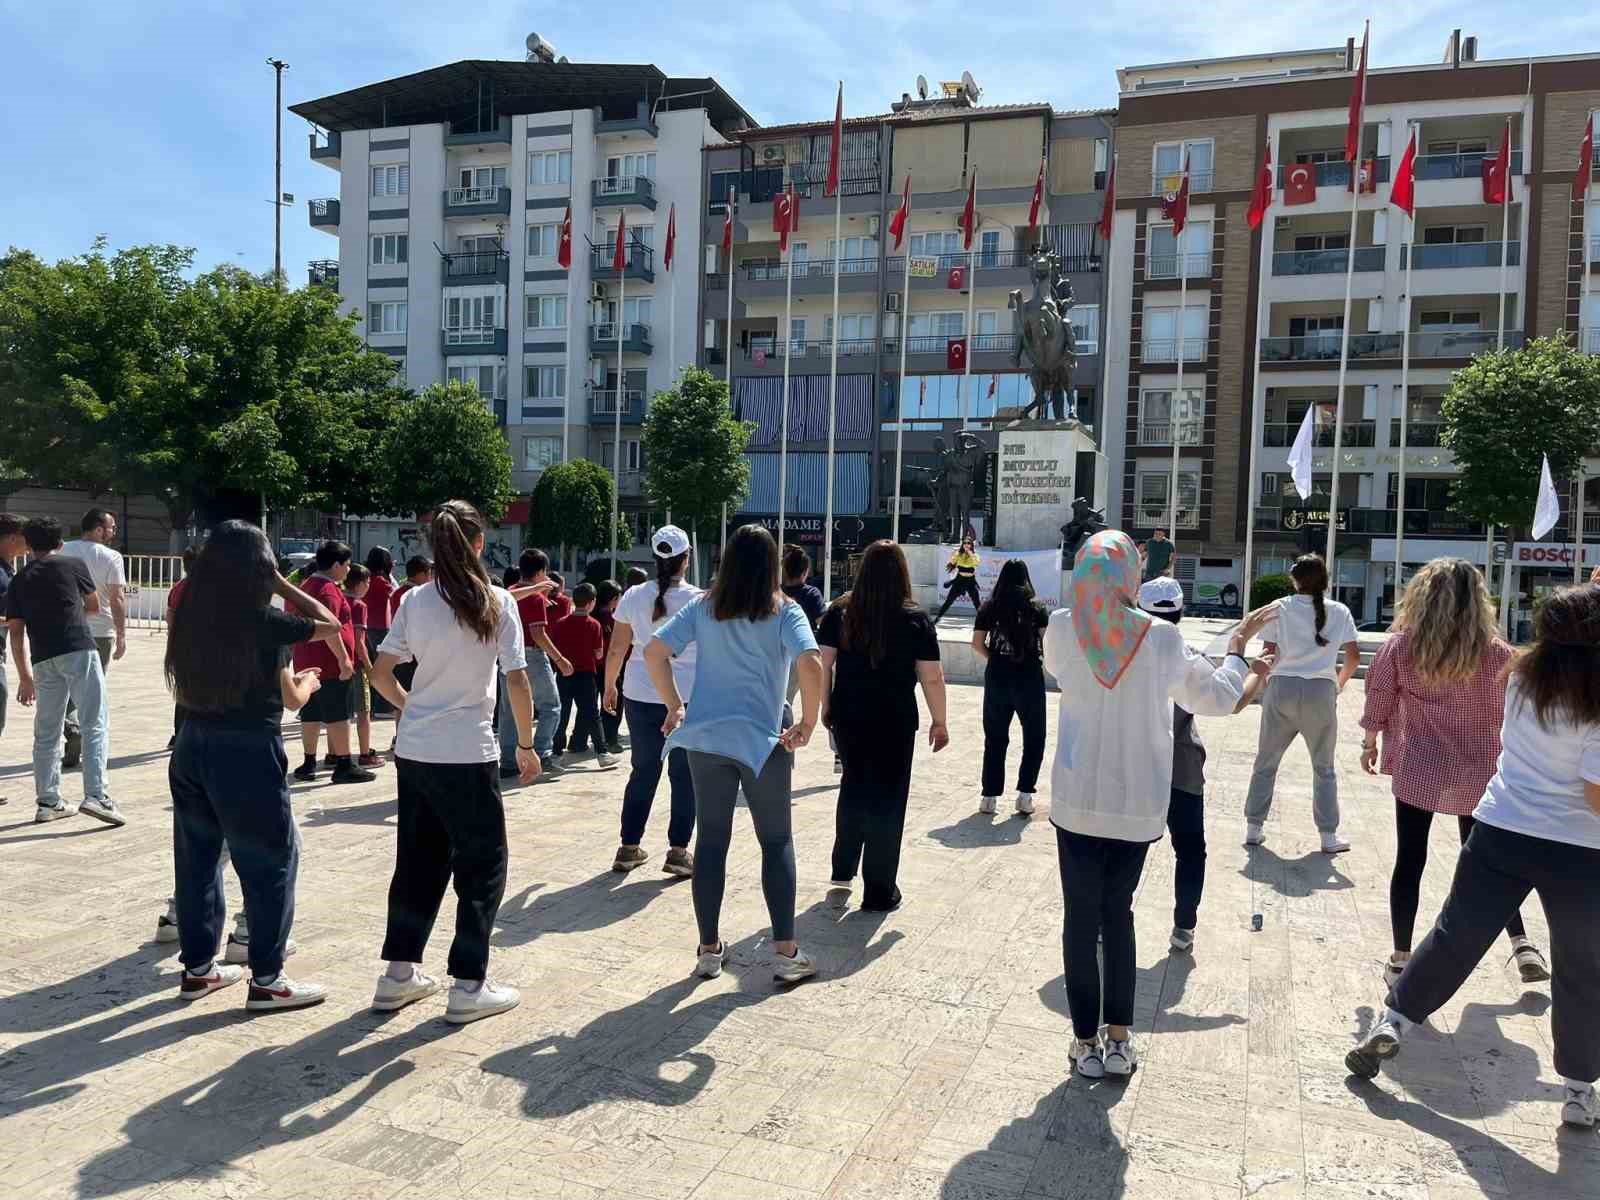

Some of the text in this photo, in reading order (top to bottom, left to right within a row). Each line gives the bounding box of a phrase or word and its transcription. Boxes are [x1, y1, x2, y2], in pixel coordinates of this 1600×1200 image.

[1003, 444, 1026, 456] NE
[1003, 460, 1058, 471] MUTLU
[1307, 511, 1346, 521] AVUKT
[761, 519, 820, 530] MADAME
[1519, 547, 1586, 562] BOSCH
